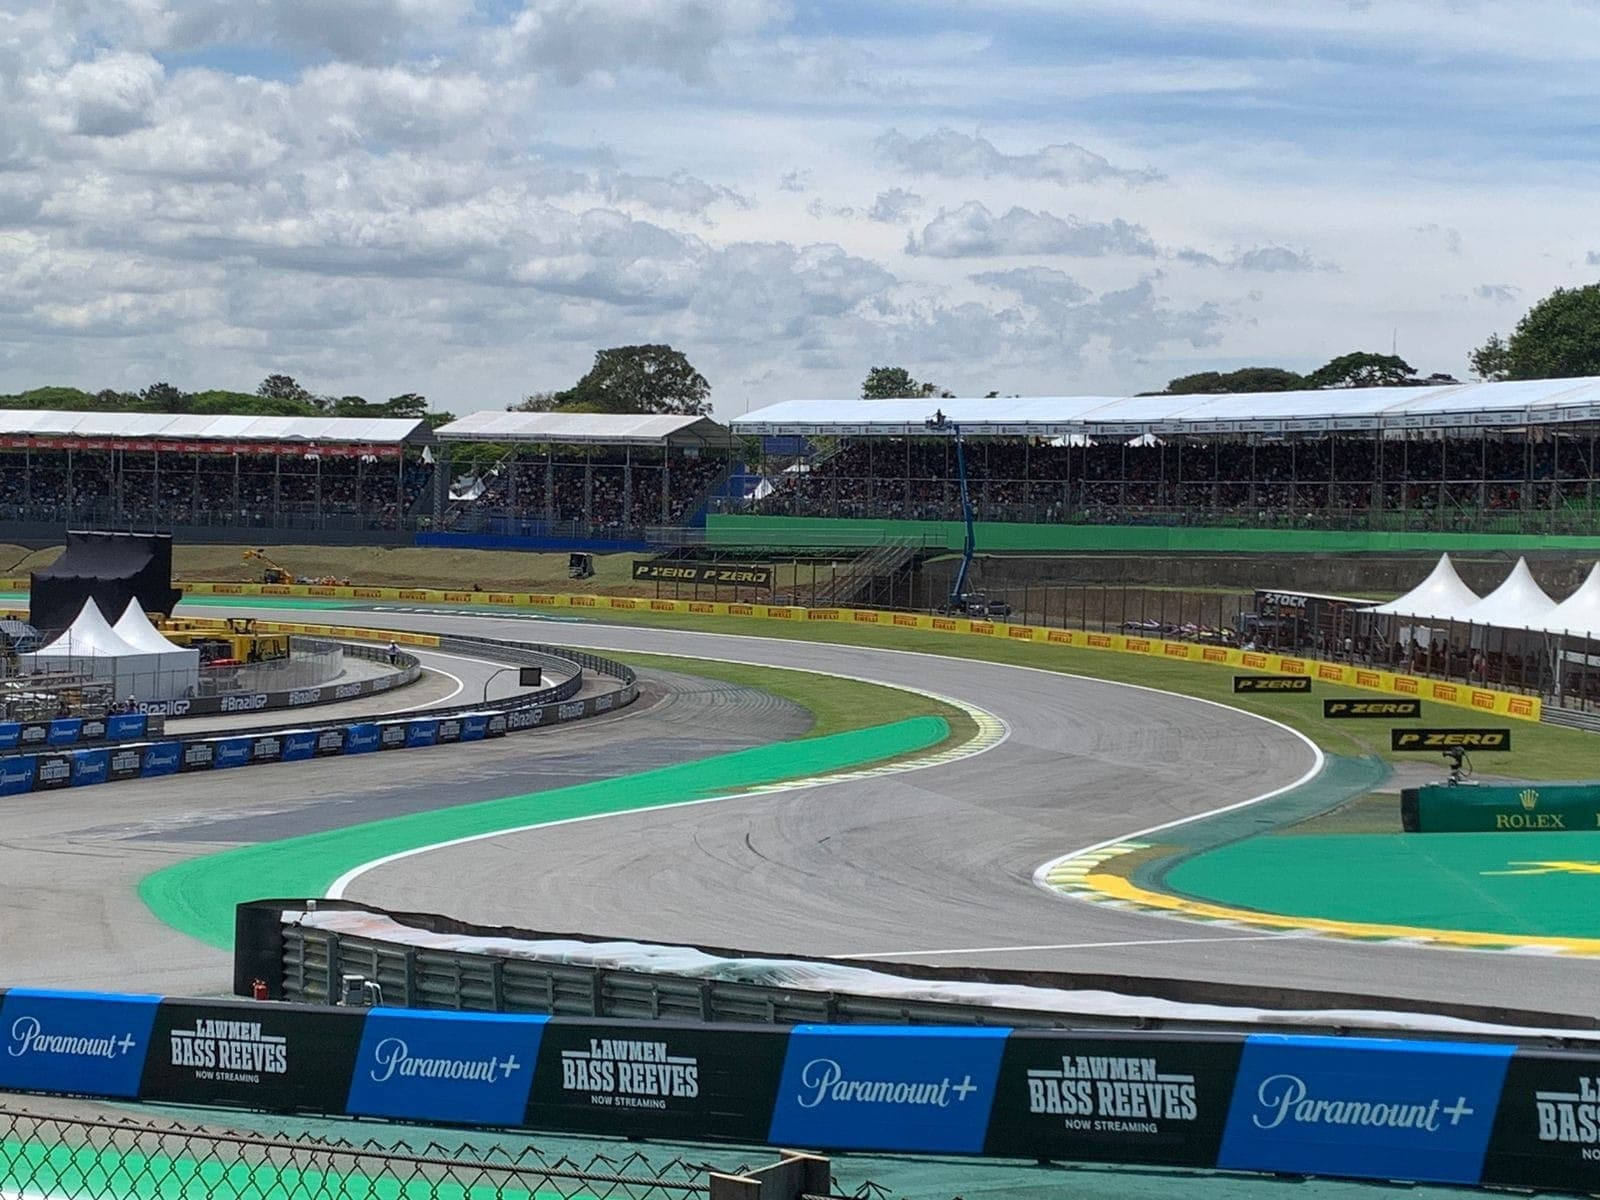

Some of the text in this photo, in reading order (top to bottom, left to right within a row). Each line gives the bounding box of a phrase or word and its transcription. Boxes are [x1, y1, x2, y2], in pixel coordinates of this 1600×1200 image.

[636, 566, 649, 576] P
[651, 567, 697, 579] ZERO
[703, 570, 717, 580] P
[1265, 593, 1308, 607] STOCK
[1238, 680, 1306, 689] P ZERO
[138, 700, 190, 715] BrazilGP
[1329, 703, 1416, 713] P ZERO
[1398, 734, 1504, 745] P ZERO
[1496, 814, 1565, 828] ROLEX
[8, 1016, 136, 1059] Paramount+
[196, 1018, 262, 1041] LAWMEN
[171, 1037, 288, 1074] BASS REEVES
[371, 1037, 521, 1083] Paramount+
[590, 1039, 667, 1063] LAWMEN
[196, 1070, 260, 1084] NOW STREAMING
[562, 1058, 699, 1098] BASS REEVES
[1062, 1056, 1156, 1081] LAWMEN
[798, 1058, 977, 1108] Paramount+
[591, 1095, 666, 1109] NOW STREAMING
[1028, 1077, 1196, 1121] BASS REEVES
[1252, 1074, 1474, 1132] Paramount+
[1065, 1119, 1158, 1134] NOW STREAMING
[1536, 1102, 1600, 1143] BAS
